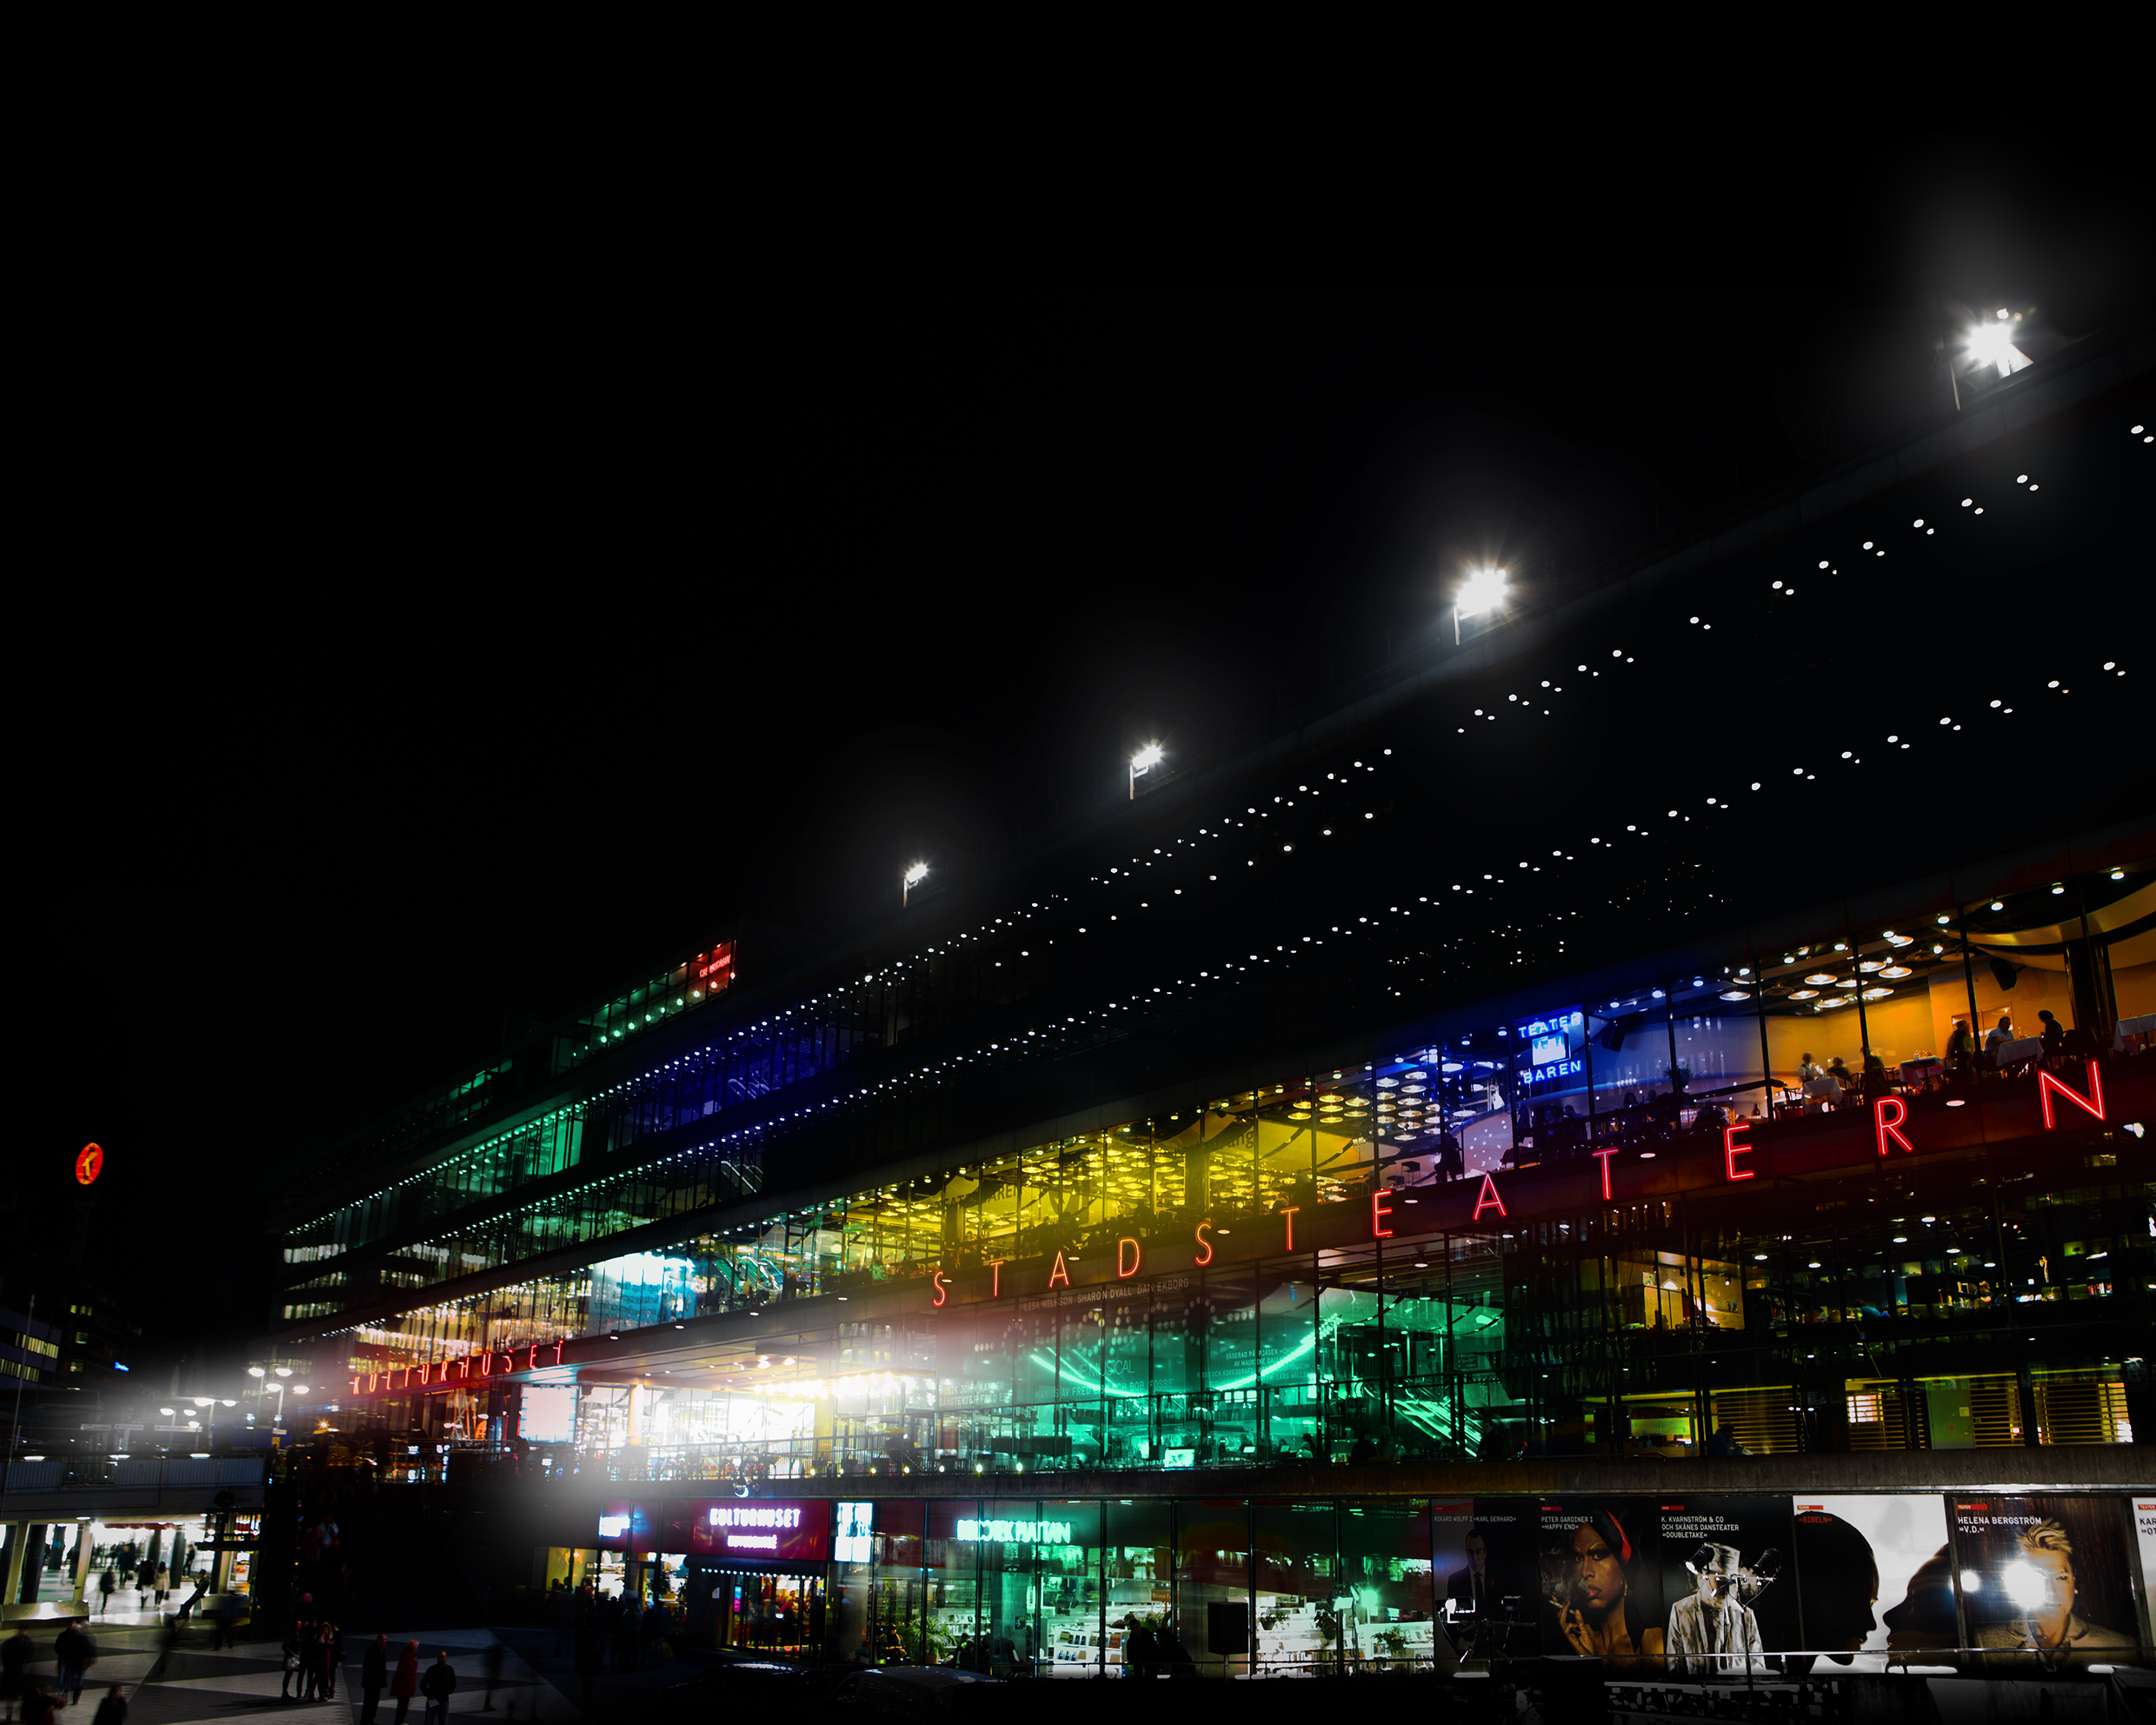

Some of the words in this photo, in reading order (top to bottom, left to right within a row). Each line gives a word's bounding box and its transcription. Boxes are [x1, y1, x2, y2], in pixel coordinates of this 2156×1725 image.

[1518, 1011, 1581, 1038] TEATER
[1523, 1060, 1581, 1083] BAREN
[931, 1060, 2106, 1308] STADSTEATERN
[1024, 1302, 1041, 1312] LISA
[1041, 1295, 1073, 1309] NILSSON
[1077, 1289, 1108, 1304] SHARON
[1109, 1287, 1133, 1299] DYALL
[1137, 1282, 1155, 1295] DAN
[1157, 1278, 1189, 1292] EKBORG
[349, 1339, 564, 1395] KULTURHUSET
[1129, 1382, 1145, 1391] BOB
[709, 1508, 801, 1528] KULTURHUSET
[1668, 1515, 1707, 1523] KVARNSTRÖM
[1957, 1515, 1990, 1525] HELENA
[1992, 1515, 2042, 1525] BERGSTRÖM
